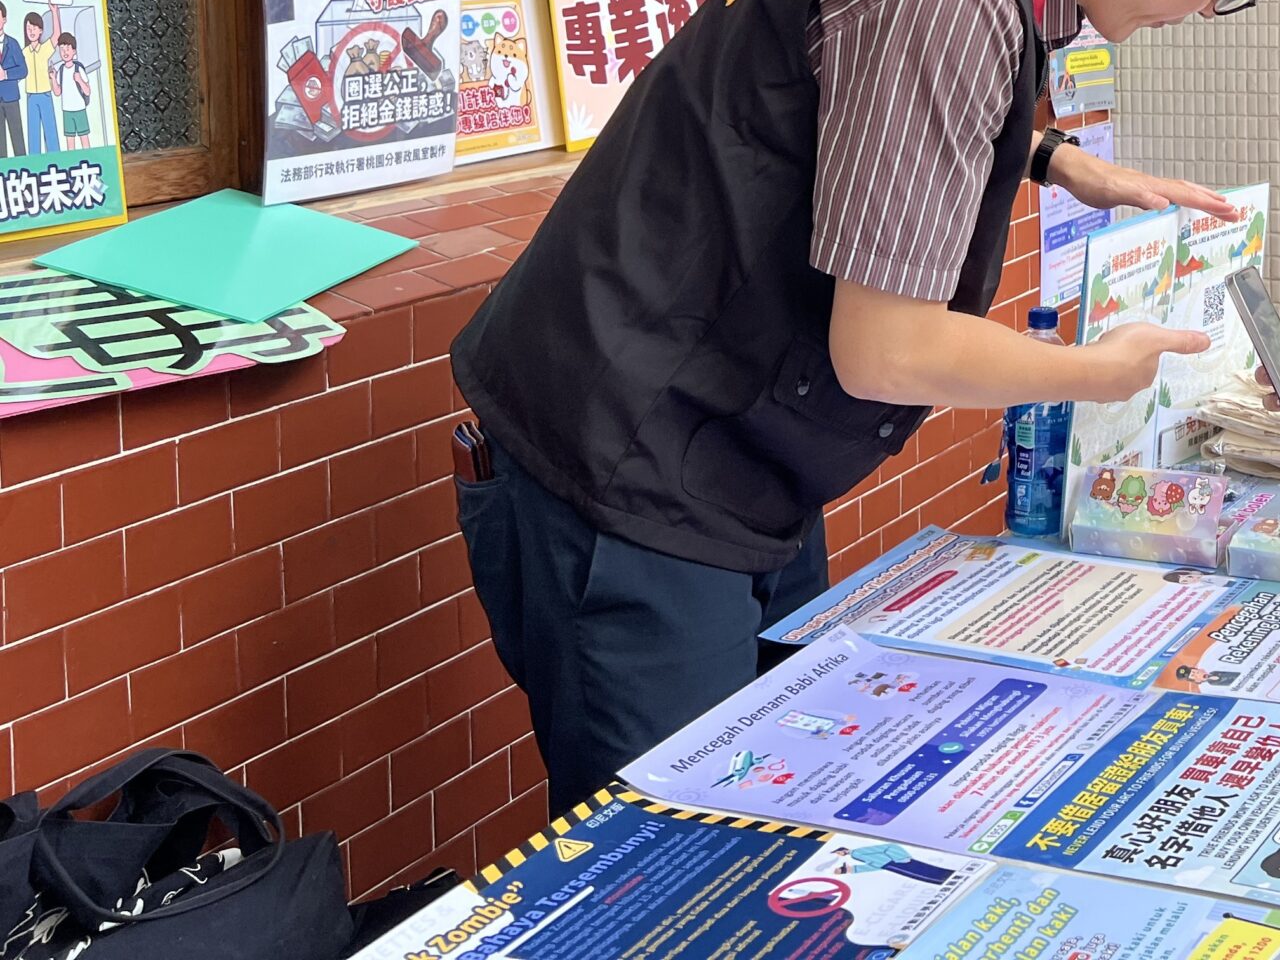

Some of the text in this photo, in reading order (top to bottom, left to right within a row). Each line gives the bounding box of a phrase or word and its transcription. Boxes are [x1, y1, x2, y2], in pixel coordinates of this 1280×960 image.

[0, 162, 105, 222] 的未來
[1208, 593, 1277, 641] Pencegahan
[667, 653, 851, 773] Mencegah Demam Babi Afrika
[1062, 835, 1091, 854] NEVER
[1082, 819, 1106, 835] LEND
[1097, 803, 1123, 819] YOUR
[1114, 790, 1135, 804] ARC
[1126, 782, 1143, 792] TO
[1135, 761, 1166, 783] FRIENDS
[1157, 749, 1176, 761] FOR
[1168, 732, 1194, 750] BUYING
[1103, 783, 1199, 862] 真心好朋友
[1180, 713, 1266, 782] 買車靠自己
[583, 802, 626, 828] 印尼文版
[986, 823, 1009, 838] 1955
[1144, 791, 1238, 869] 名字借他人
[1196, 842, 1219, 857] TRUE
[1210, 820, 1238, 841] FRIENDS
[1246, 790, 1262, 802] ASK
[1254, 782, 1269, 792] TO
[1213, 844, 1233, 858] BUY
[1224, 830, 1244, 846] YOUR
[1236, 815, 1257, 831] OWN
[1248, 795, 1274, 816] VEHICLE
[1220, 845, 1249, 869] LENDING
[1241, 829, 1263, 844] YOUR
[456, 821, 663, 960] Bahaya Tersembunyi!
[963, 895, 1025, 931] kaki,
[1018, 887, 1066, 914] dan
[1029, 904, 1086, 937] kaki
[1150, 902, 1195, 934] melalui
[1248, 937, 1273, 954] 1200
